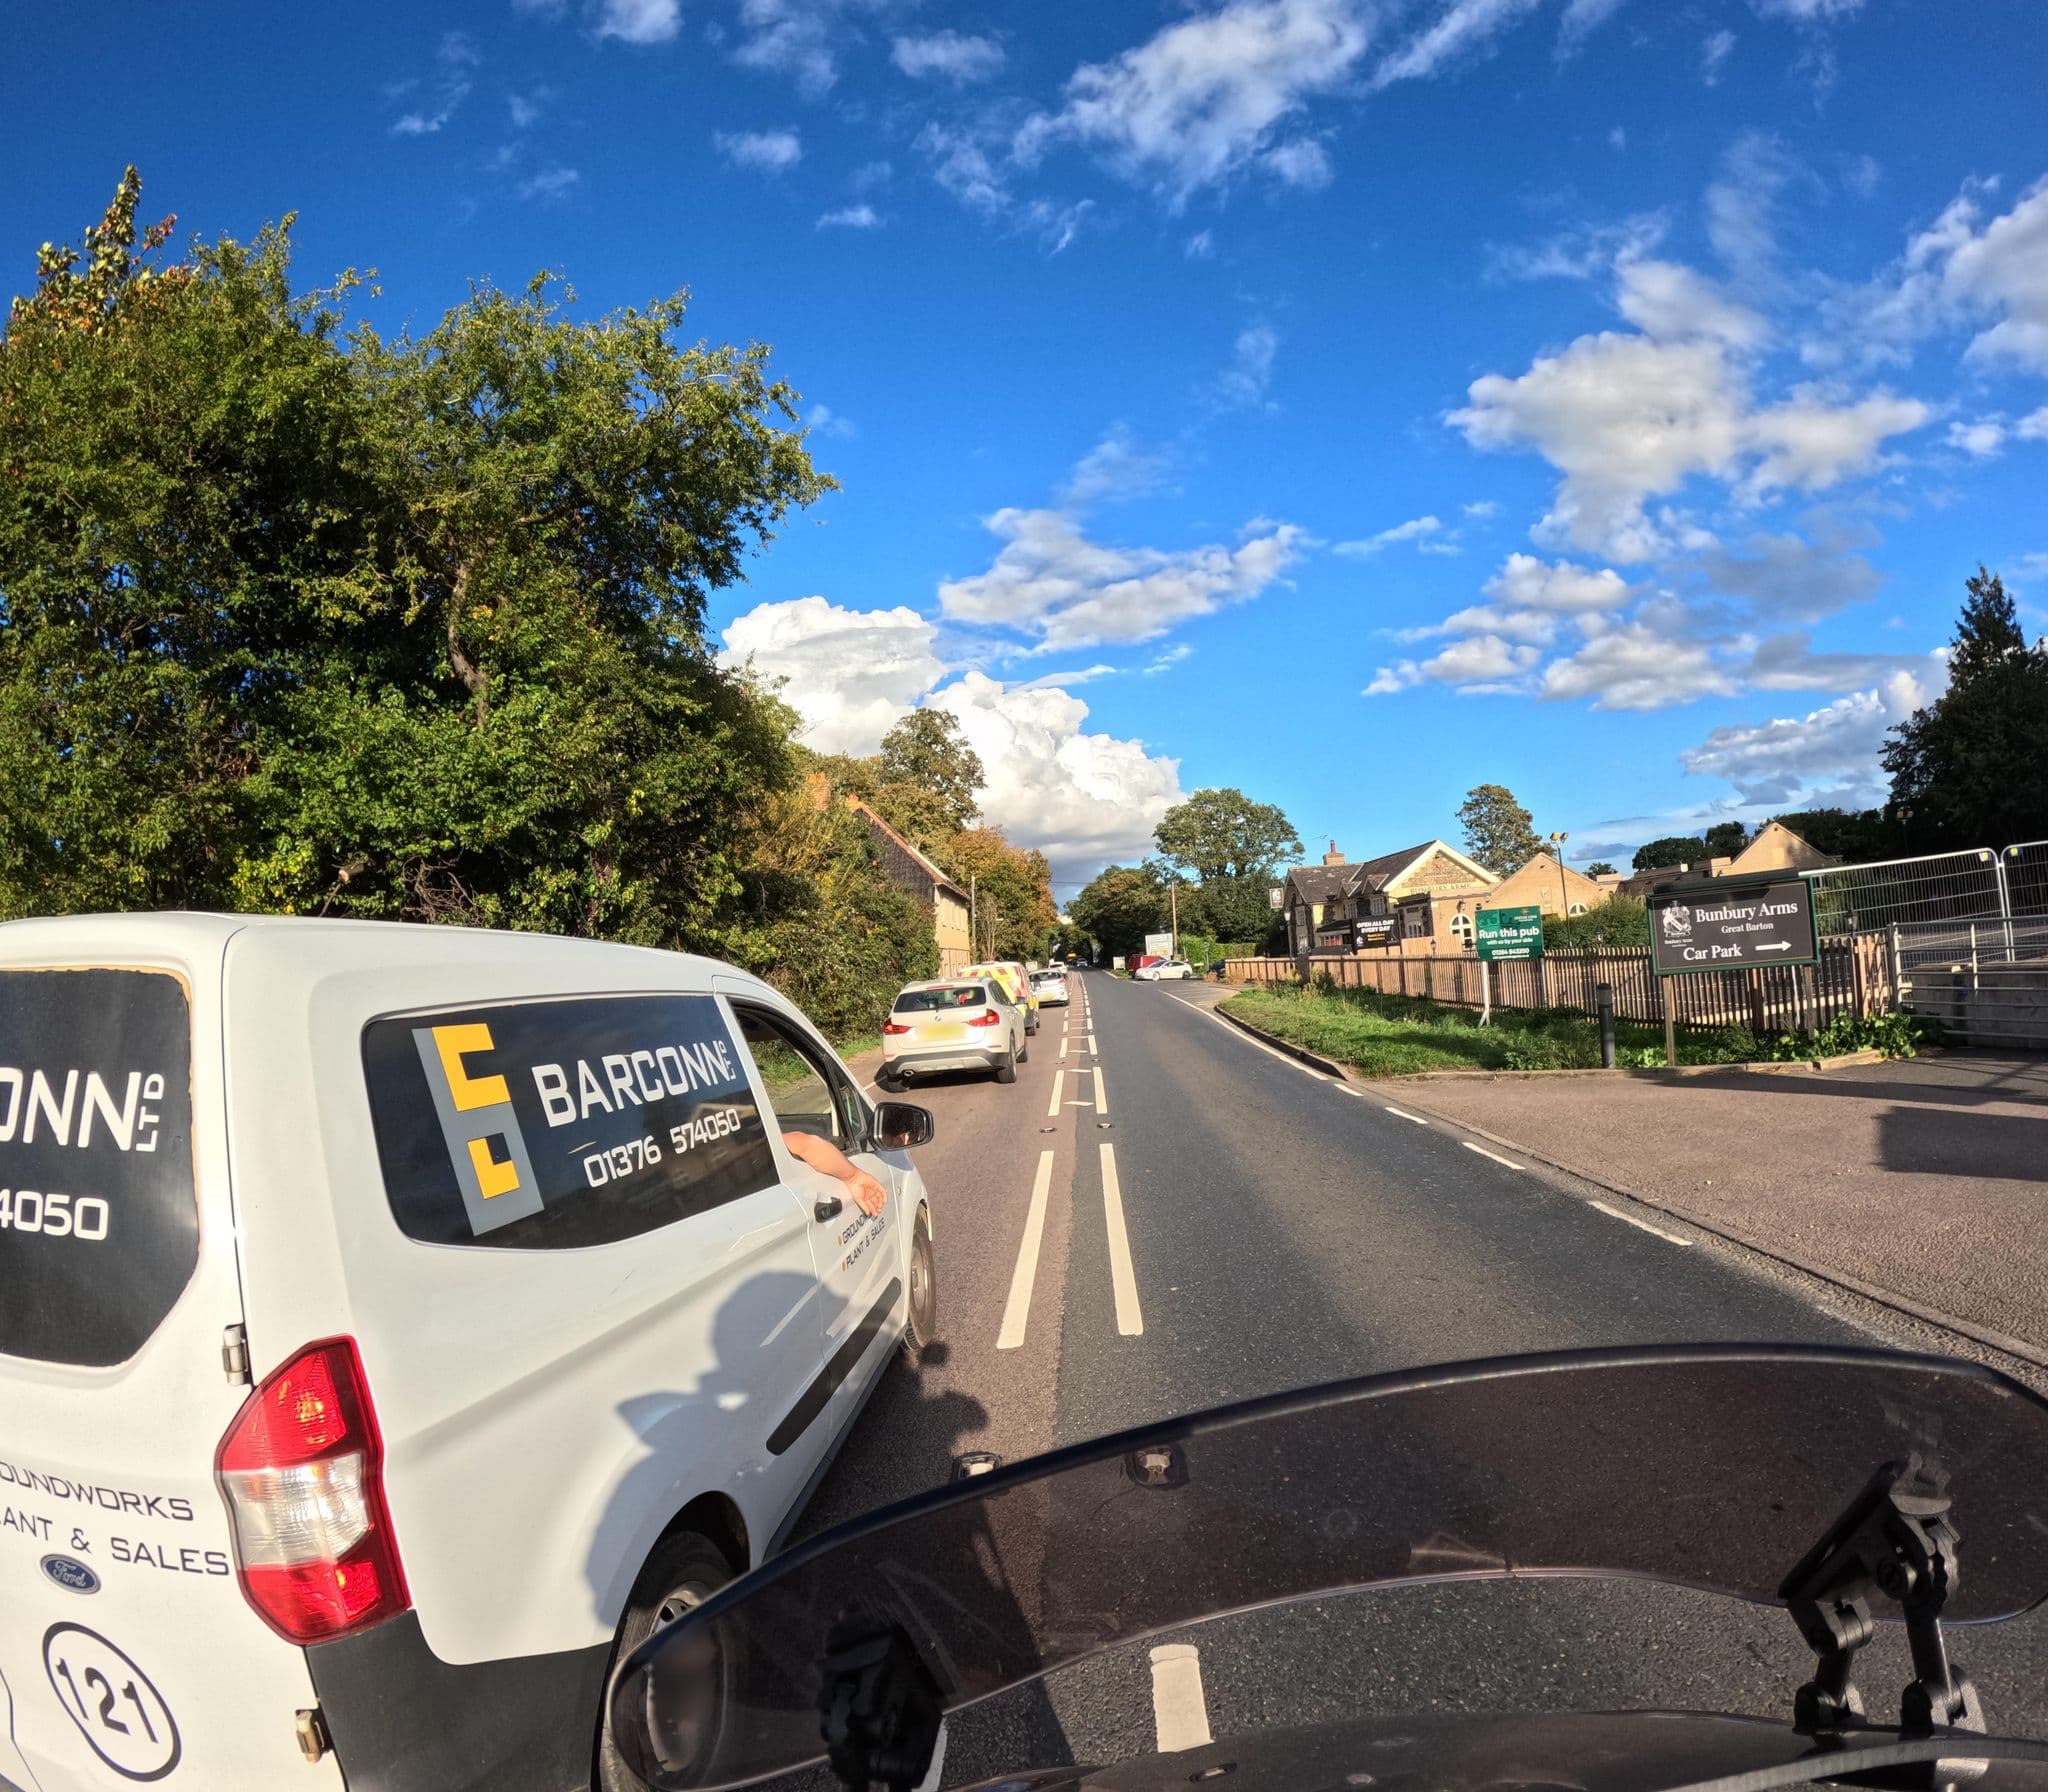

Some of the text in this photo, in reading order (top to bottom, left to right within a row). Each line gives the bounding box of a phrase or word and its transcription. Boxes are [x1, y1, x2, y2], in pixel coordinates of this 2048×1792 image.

[1478, 925, 1540, 939] Run this pub
[1695, 902, 1798, 923] Bunbury Arms
[1721, 922, 1774, 934] Great Barton
[1683, 943, 1743, 961] Car Park
[136, 1073, 165, 1152] LTD
[531, 1039, 731, 1128] BARCONN
[583, 1107, 742, 1189] 01376 574050
[0, 1461, 195, 1522] OUNDWORKS
[0, 1506, 230, 1576] ANT & SALES
[51, 1560, 87, 1587] Ford
[56, 1657, 159, 1744] 121
